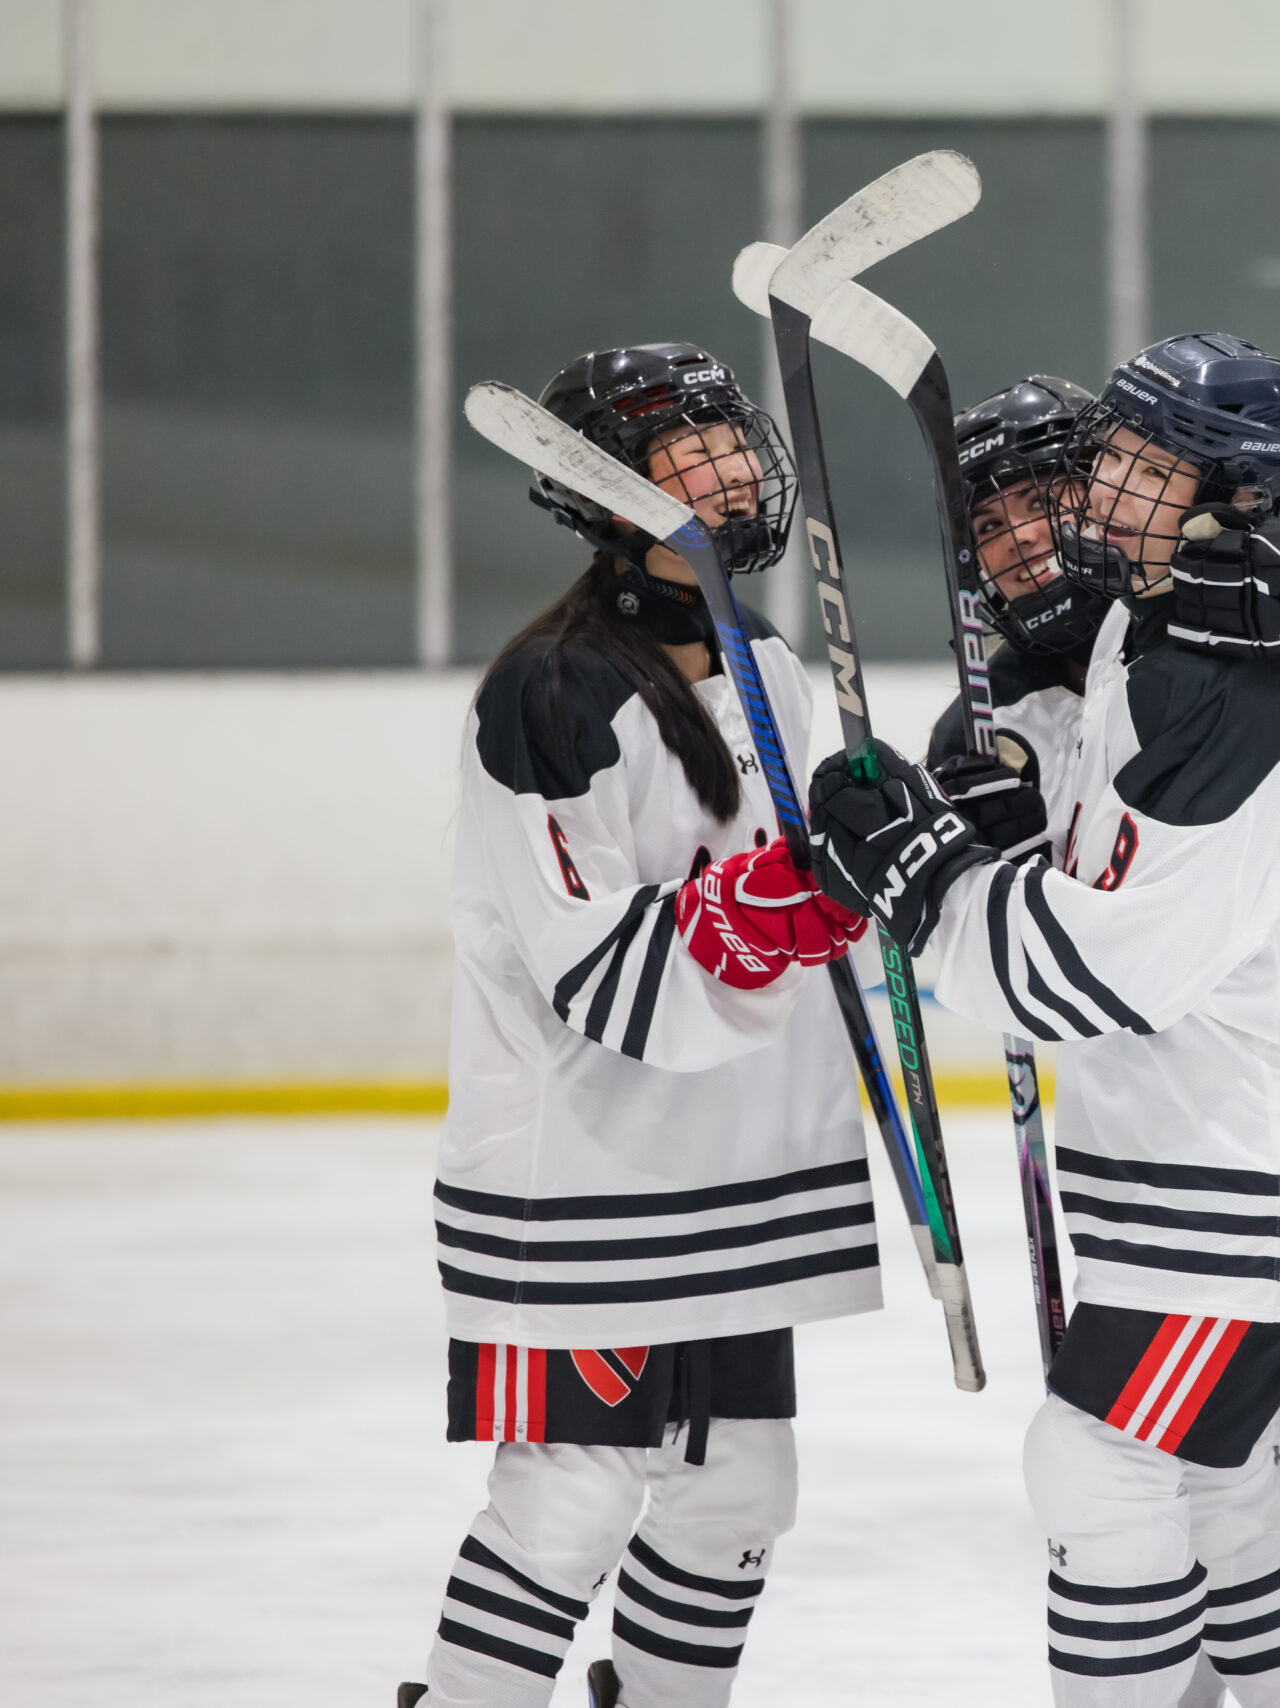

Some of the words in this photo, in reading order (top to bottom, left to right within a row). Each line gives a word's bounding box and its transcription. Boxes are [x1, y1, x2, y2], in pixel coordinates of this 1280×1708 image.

[682, 368, 726, 385] CCM
[1116, 379, 1158, 405] BAUER
[958, 432, 1005, 465] CCM
[806, 515, 864, 718] CCM
[1025, 597, 1072, 630] CCM
[716, 619, 803, 827] WARRIOR
[958, 589, 1000, 757] AUER
[873, 812, 967, 920] CCM
[879, 928, 920, 1071] SPEED
